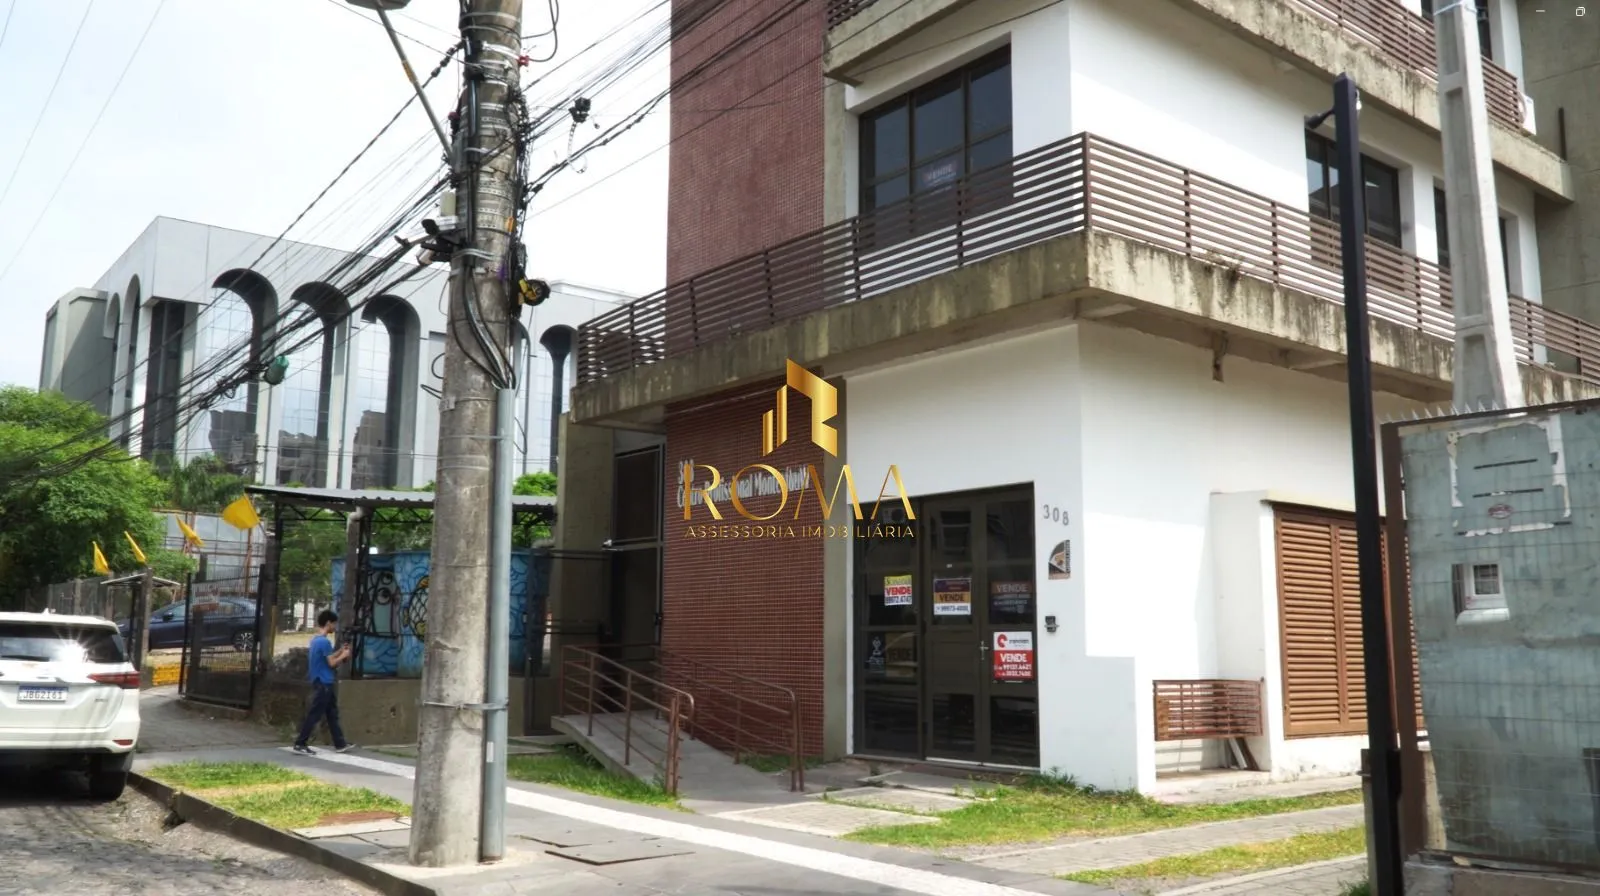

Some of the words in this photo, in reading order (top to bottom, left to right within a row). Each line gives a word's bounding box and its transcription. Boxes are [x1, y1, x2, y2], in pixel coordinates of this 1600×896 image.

[1043, 503, 1069, 526] 308
[886, 586, 912, 596] VENDE
[996, 583, 1029, 593] VENDE
[939, 593, 965, 602] VENDE
[1000, 653, 1027, 663] VENDE
